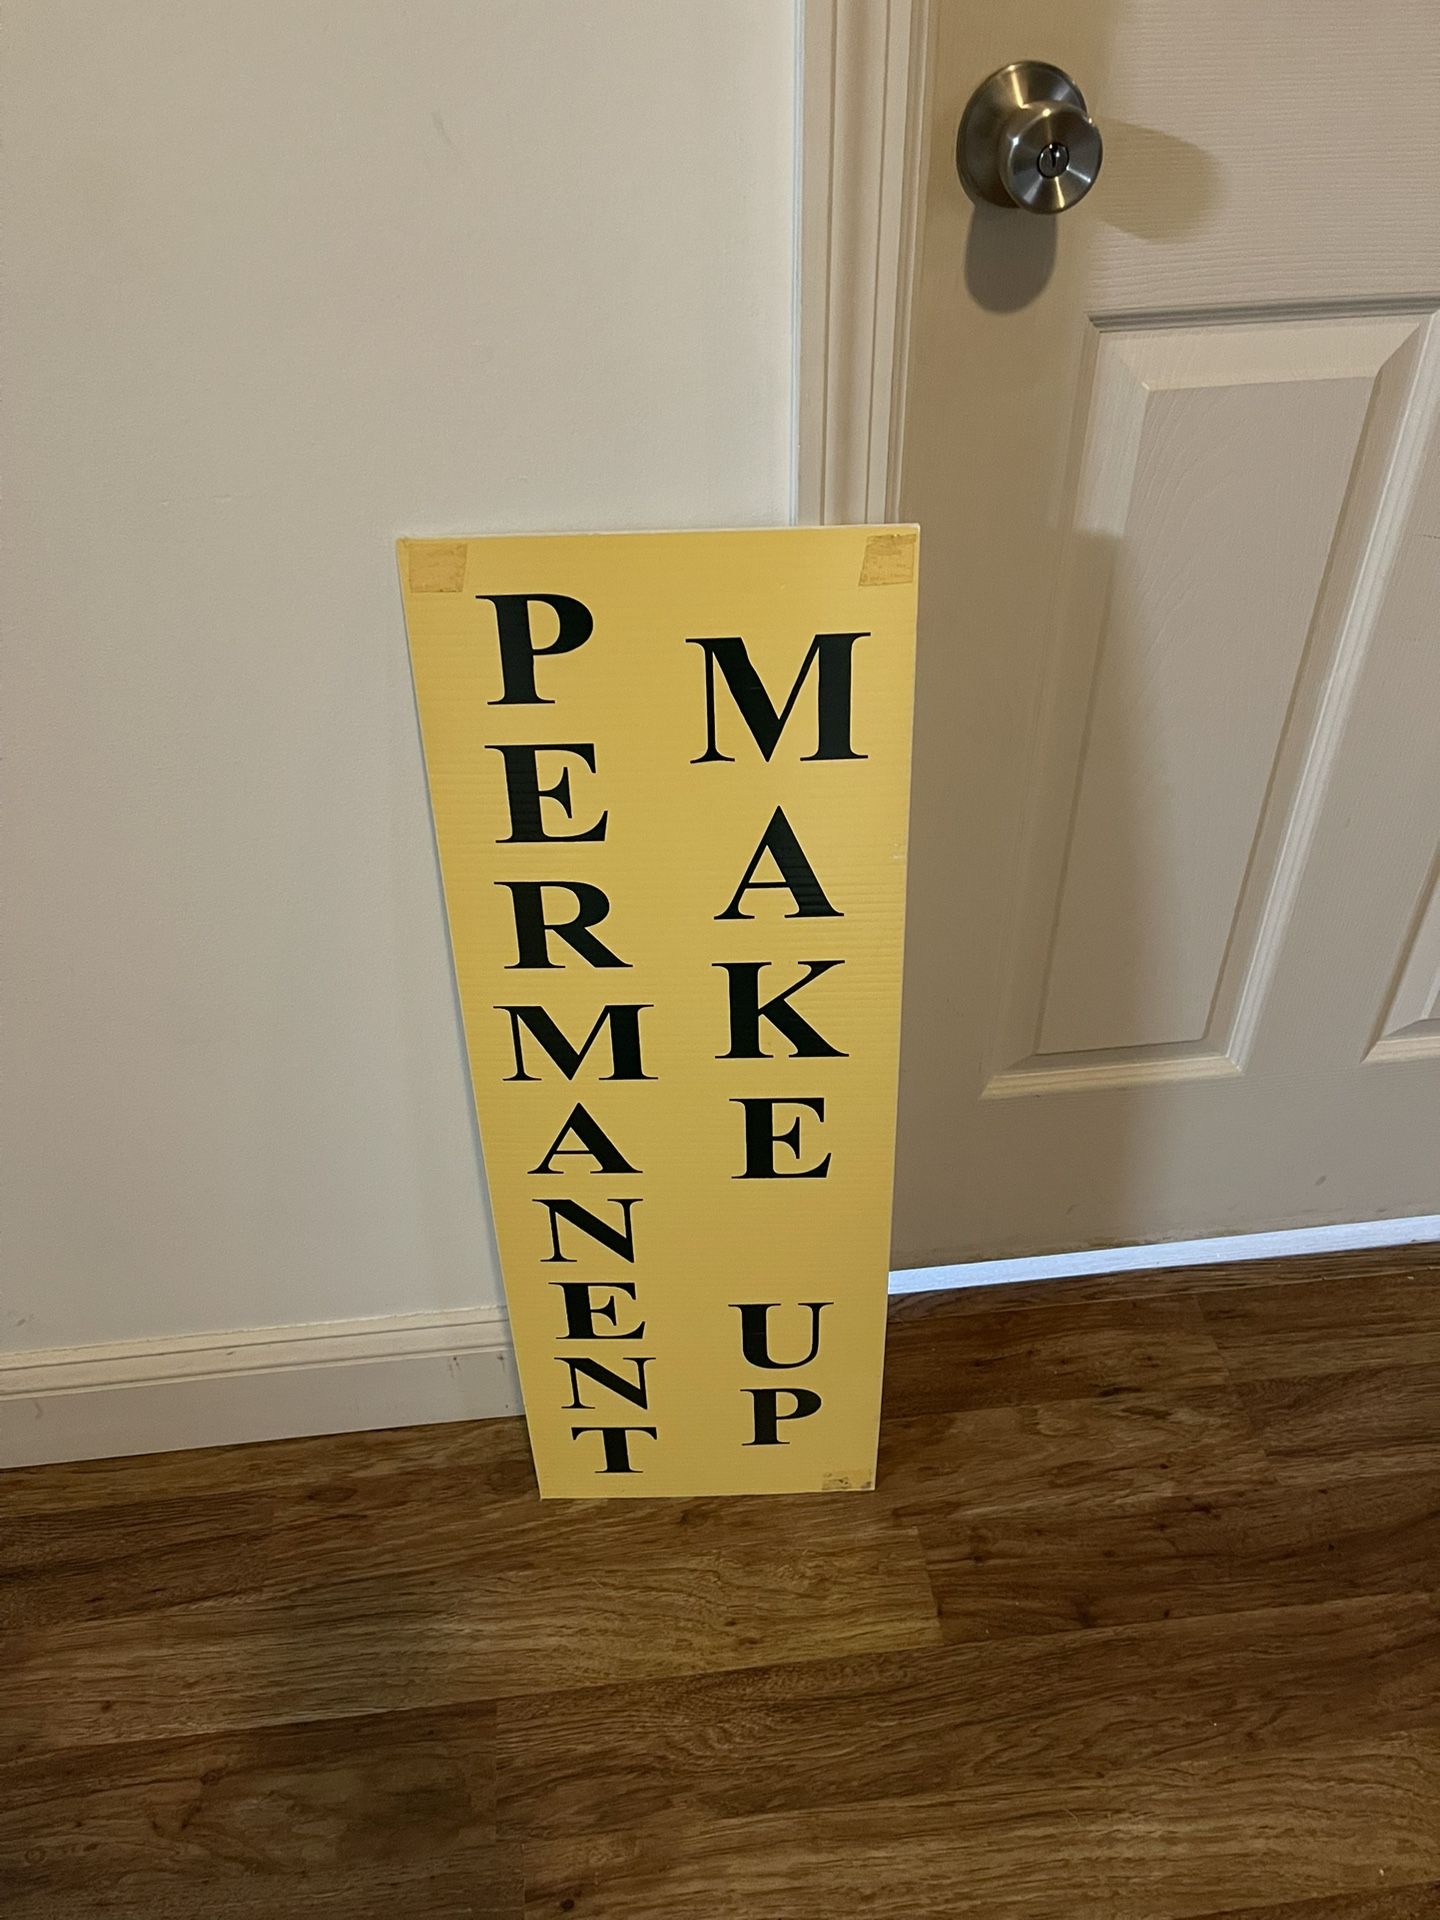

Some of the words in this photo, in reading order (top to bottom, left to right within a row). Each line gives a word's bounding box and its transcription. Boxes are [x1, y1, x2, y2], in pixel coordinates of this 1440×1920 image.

[475, 593, 659, 1474] PERMANENT
[685, 632, 871, 1180] MAKE
[727, 1302, 834, 1446] UP
